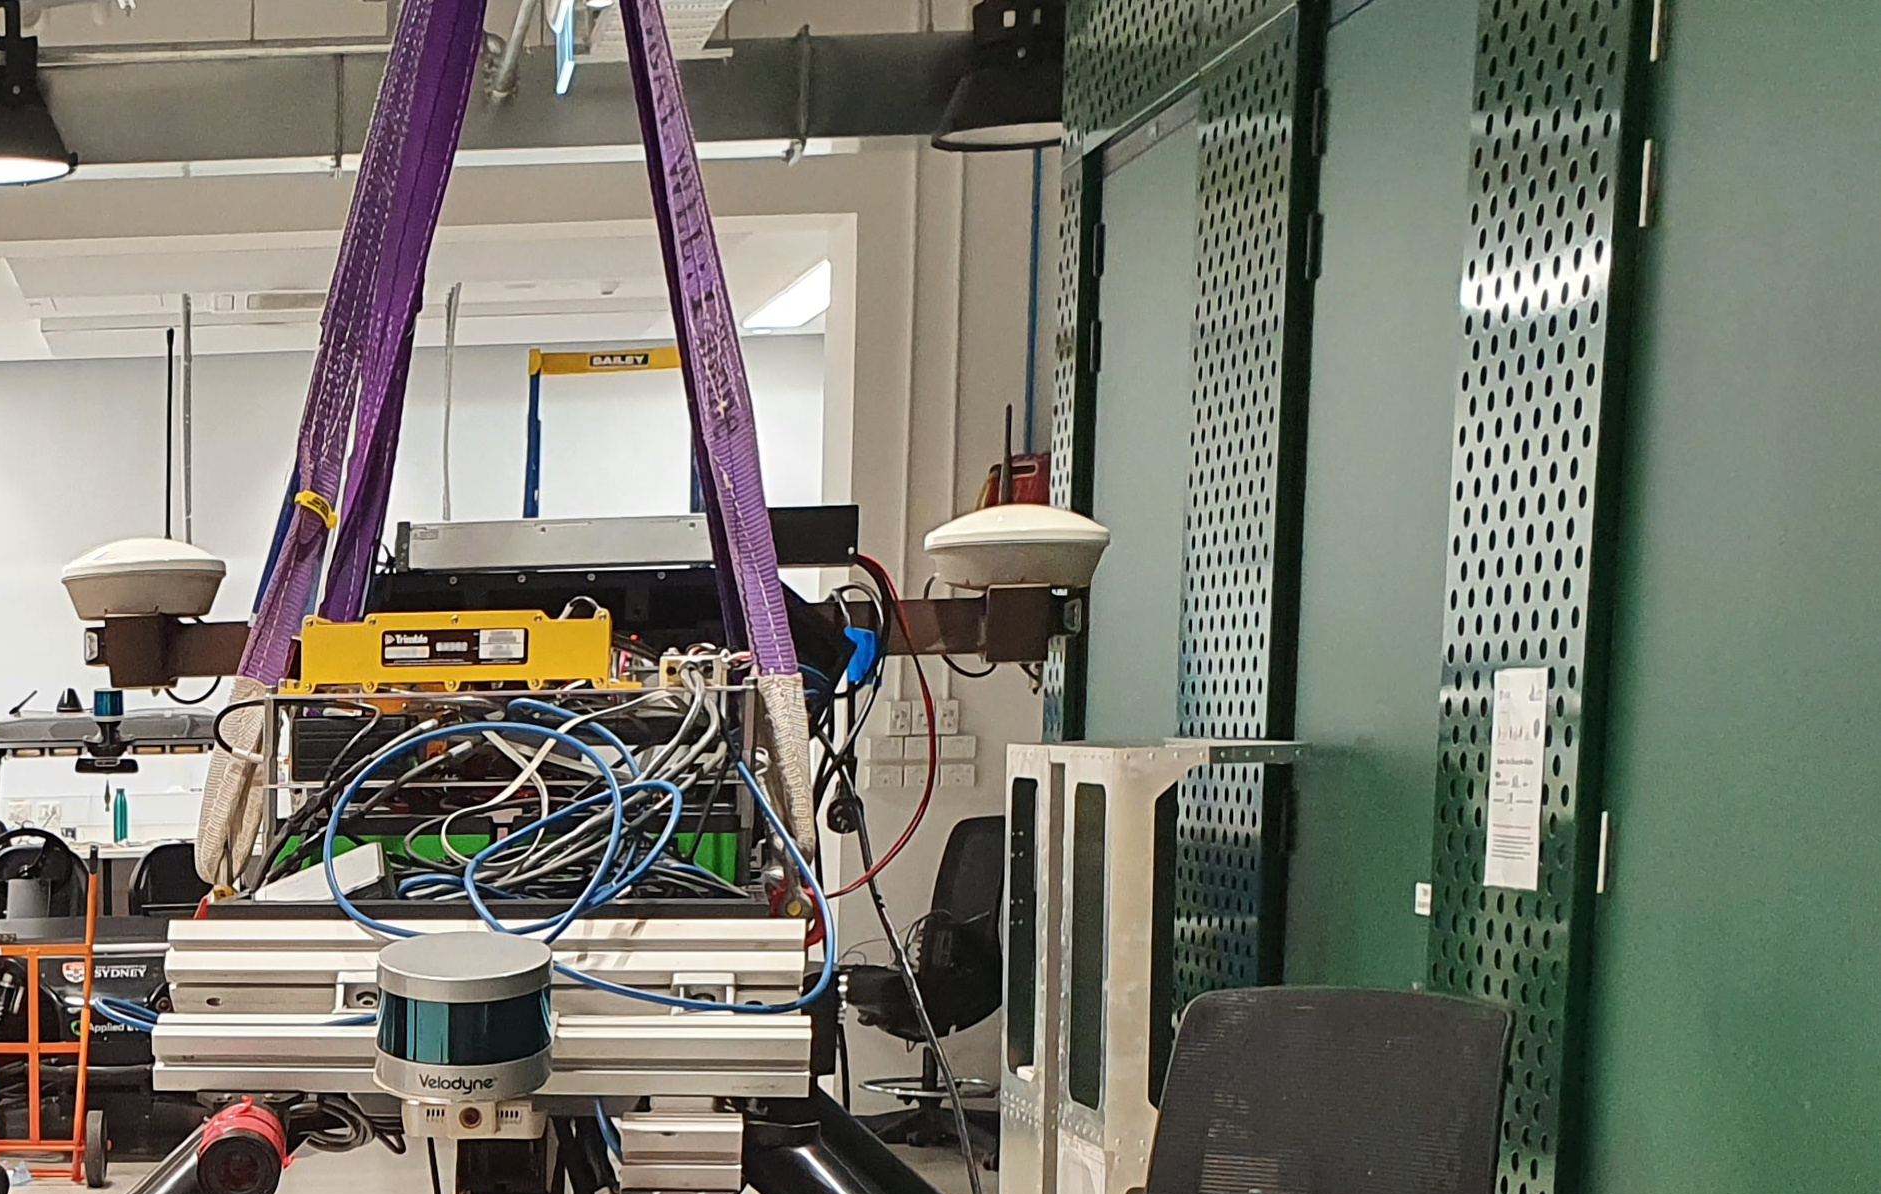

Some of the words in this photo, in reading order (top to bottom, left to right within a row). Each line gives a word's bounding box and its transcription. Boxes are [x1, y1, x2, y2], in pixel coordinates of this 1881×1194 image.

[592, 354, 645, 367] BAILEY
[395, 634, 429, 645] Trimble
[94, 968, 147, 978] SYDNEY
[89, 1022, 125, 1035] Applied
[419, 1073, 495, 1095] Velodyne
